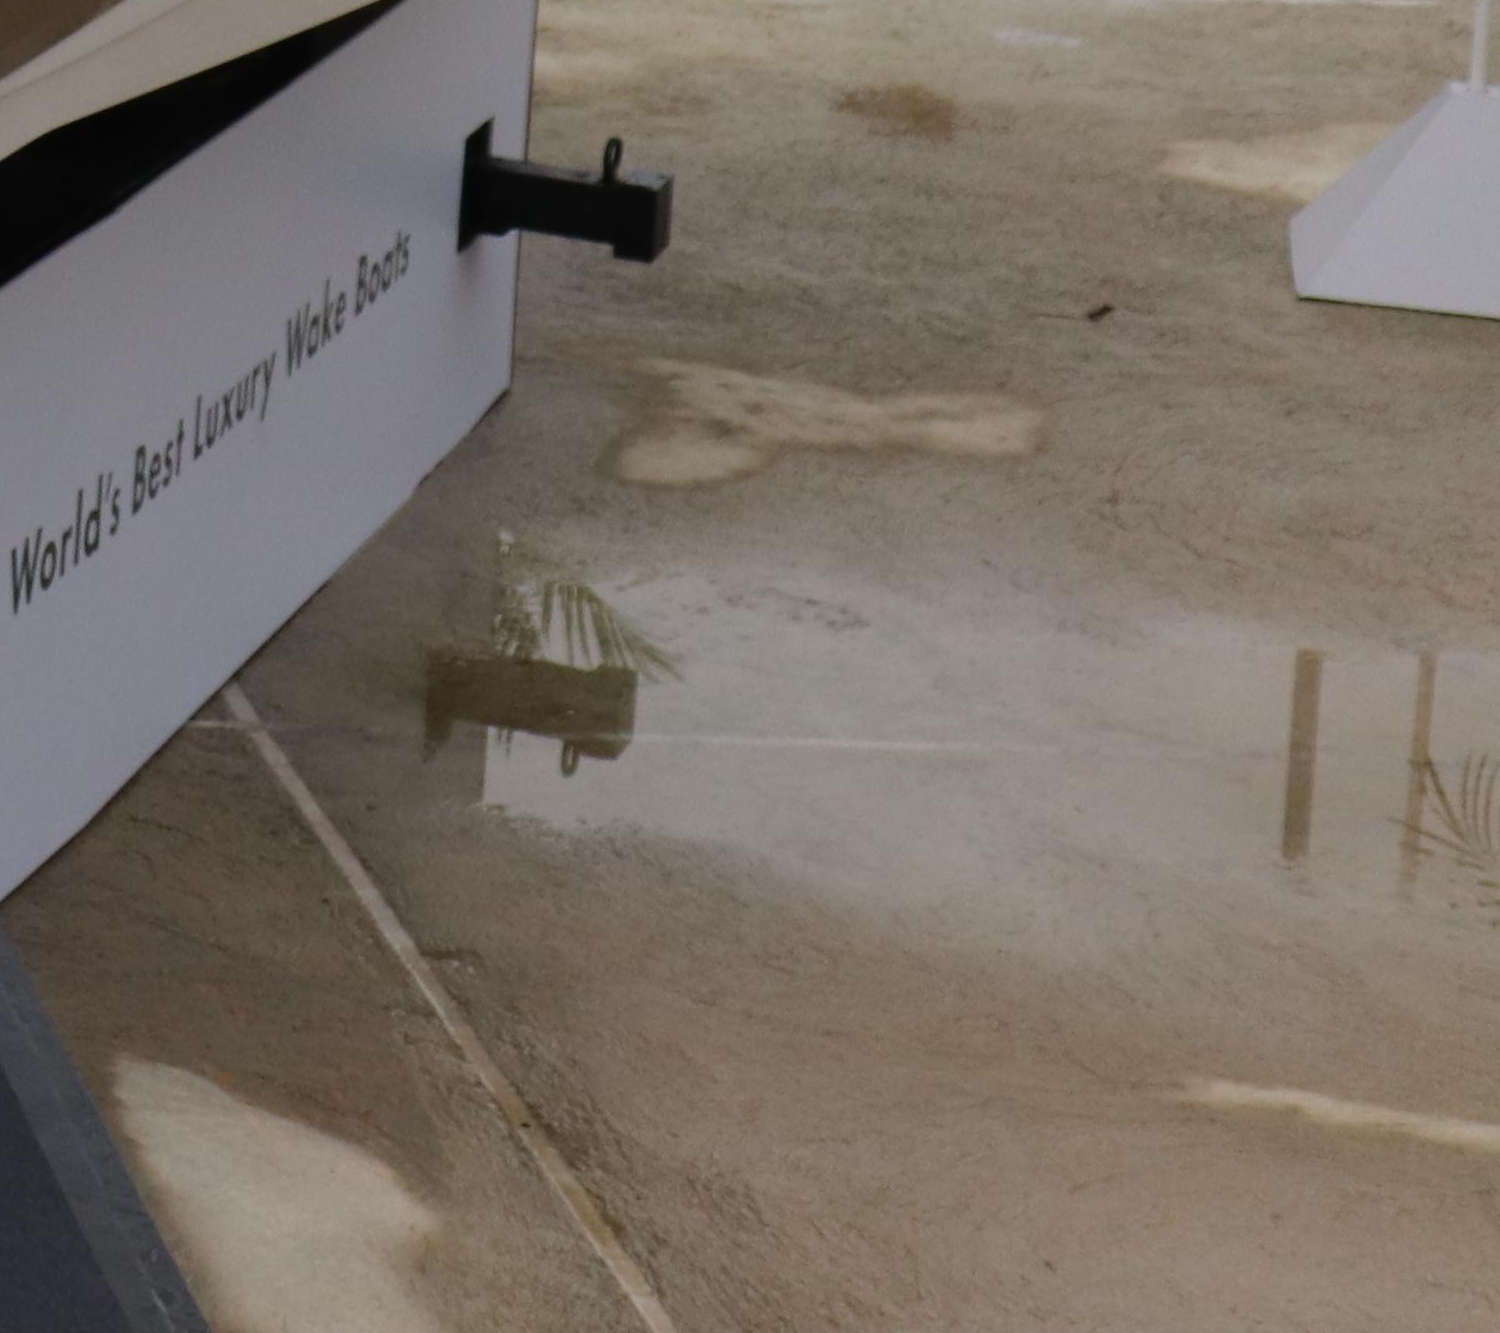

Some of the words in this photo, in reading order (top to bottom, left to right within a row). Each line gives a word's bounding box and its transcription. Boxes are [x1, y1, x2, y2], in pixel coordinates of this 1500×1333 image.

[10, 471, 121, 616] World's
[132, 418, 185, 516] Best
[193, 349, 277, 461] Luxury
[286, 278, 347, 378] Wake
[355, 231, 412, 317] Boats
